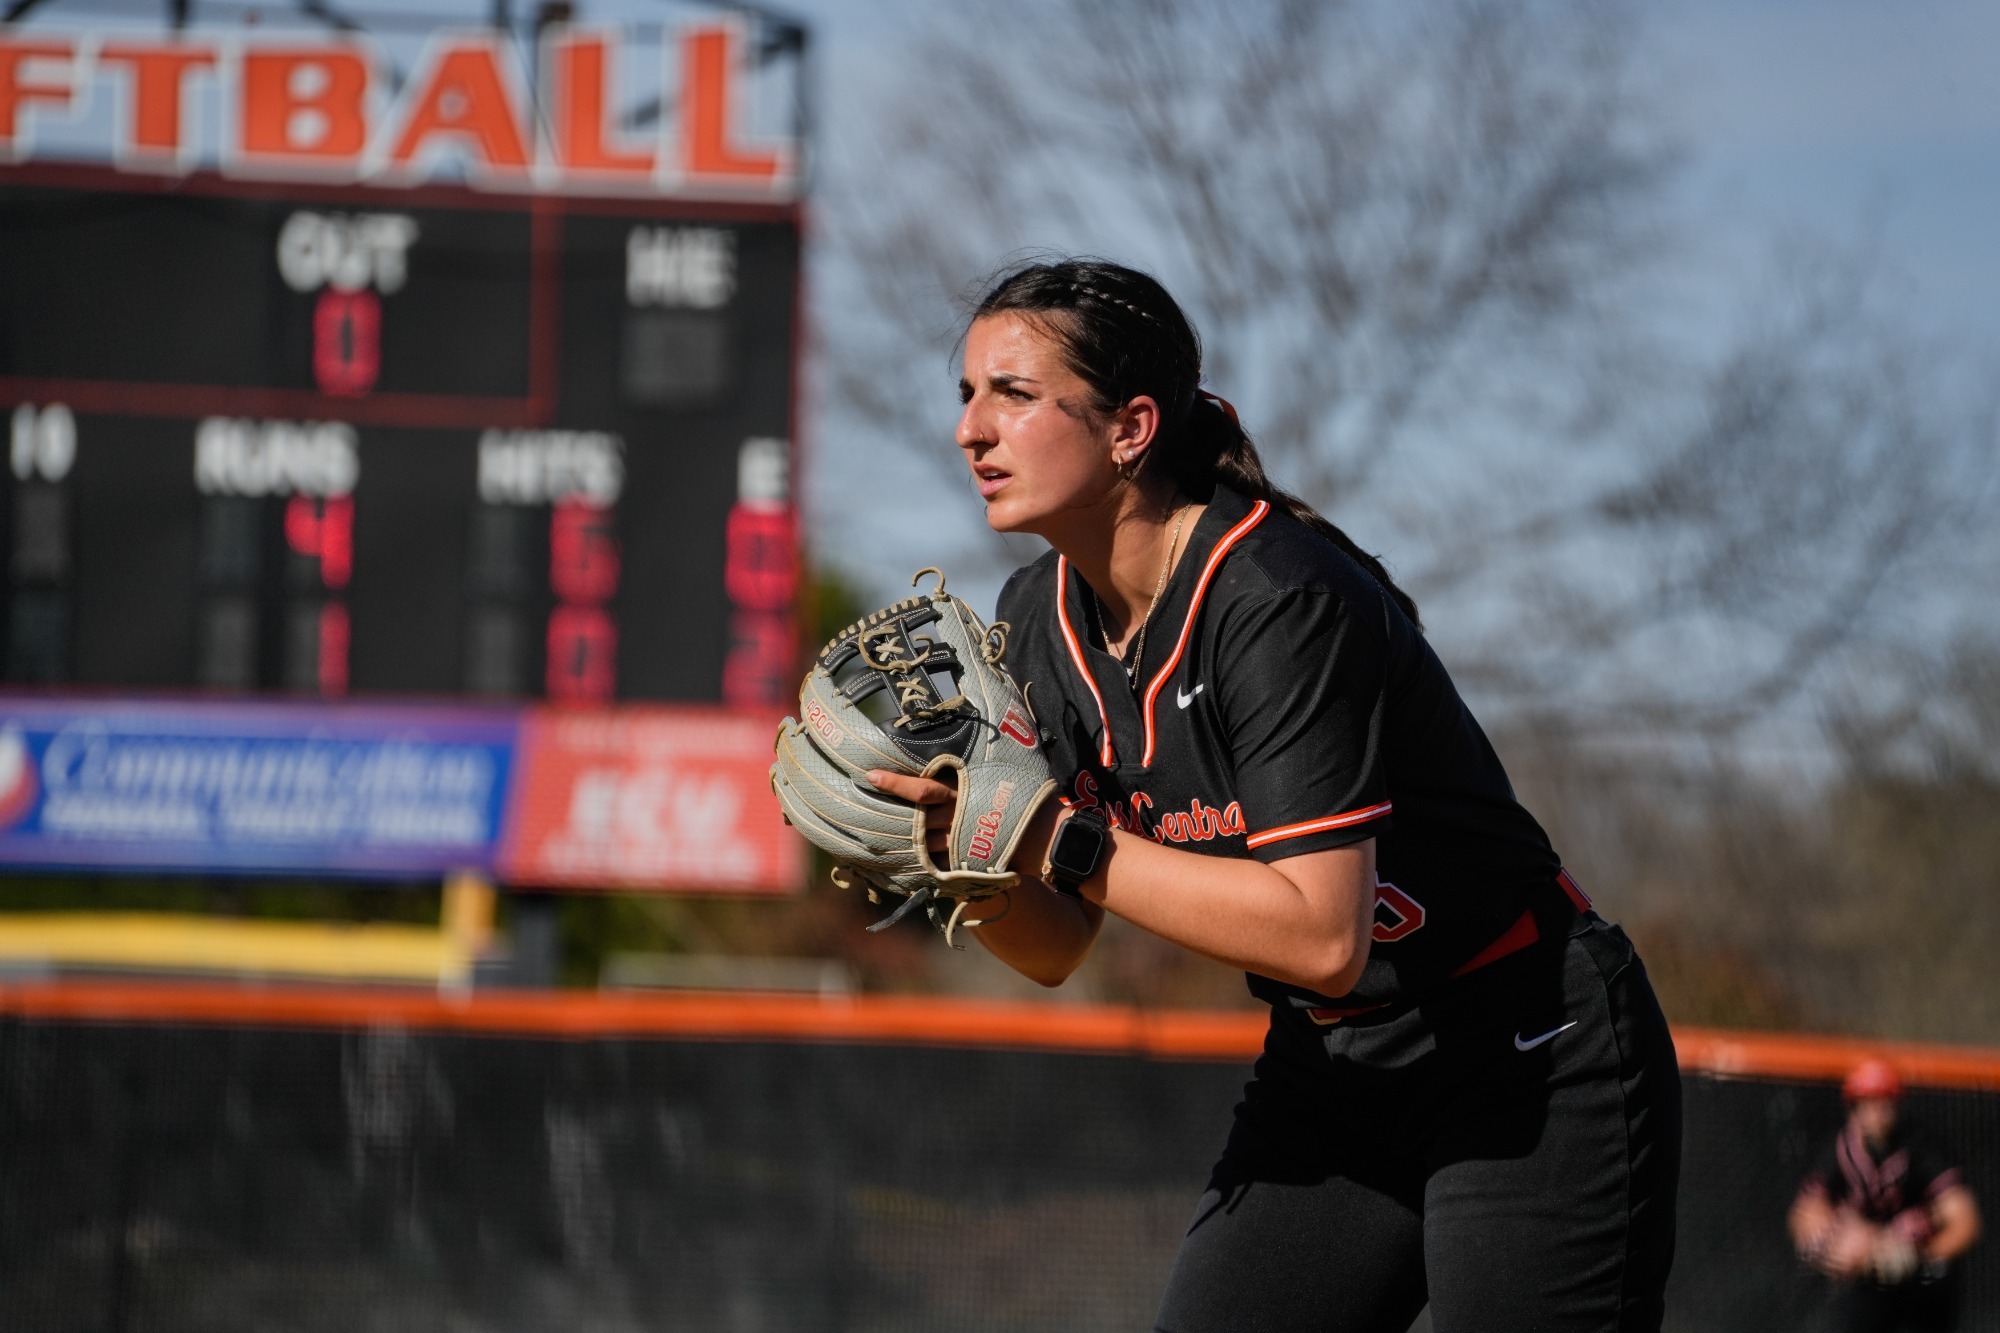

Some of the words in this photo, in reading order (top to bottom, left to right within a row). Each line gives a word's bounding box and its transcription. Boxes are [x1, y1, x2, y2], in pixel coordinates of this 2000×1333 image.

[277, 210, 418, 292] OUT
[313, 288, 382, 396] 0
[195, 416, 358, 497] RUNS
[478, 430, 625, 510] HITS
[968, 779, 1015, 861] Wilson
